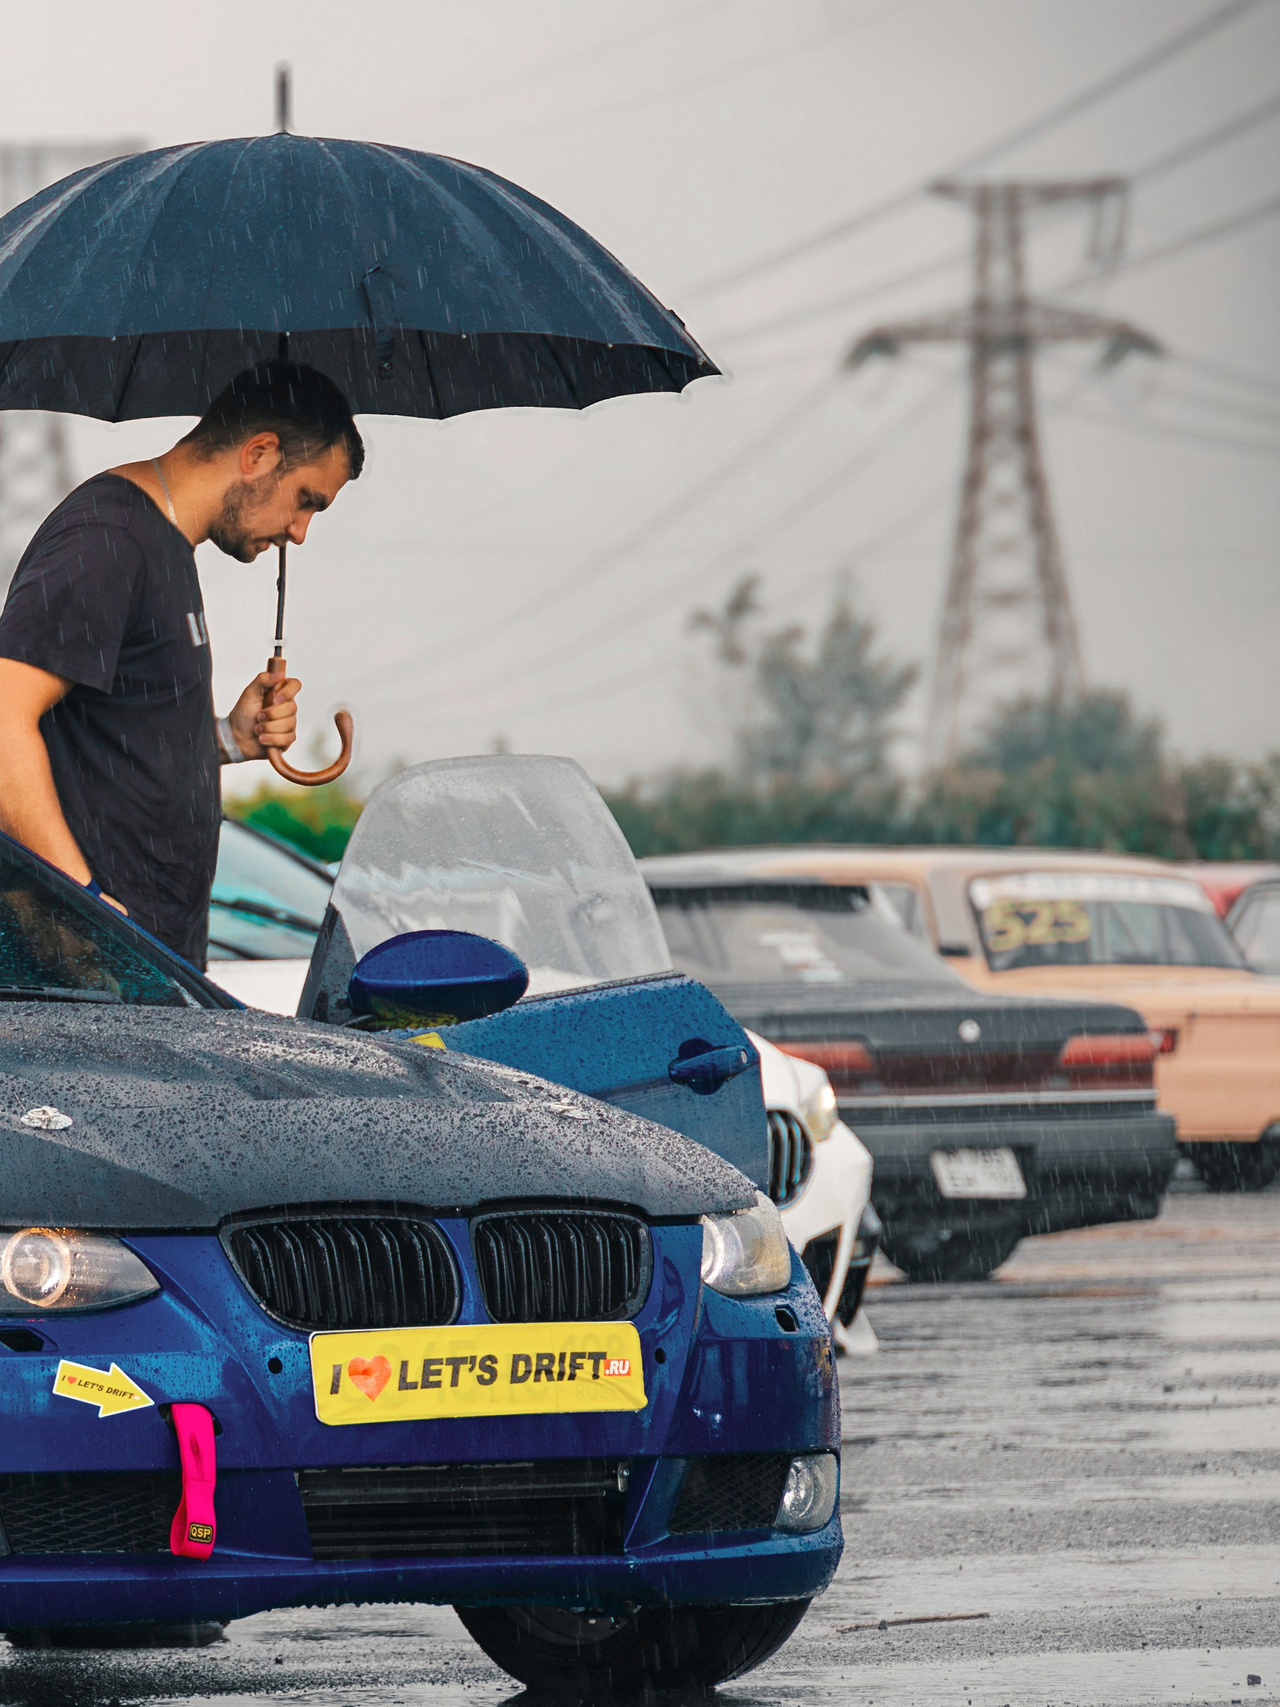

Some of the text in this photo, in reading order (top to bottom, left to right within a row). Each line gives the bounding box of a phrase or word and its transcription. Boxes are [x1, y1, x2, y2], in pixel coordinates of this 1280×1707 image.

[985, 898, 1092, 952] 525
[77, 1379, 105, 1392] LET'S
[330, 1364, 342, 1395] I
[397, 1354, 498, 1391] LET'S
[191, 1527, 211, 1540] QSP
